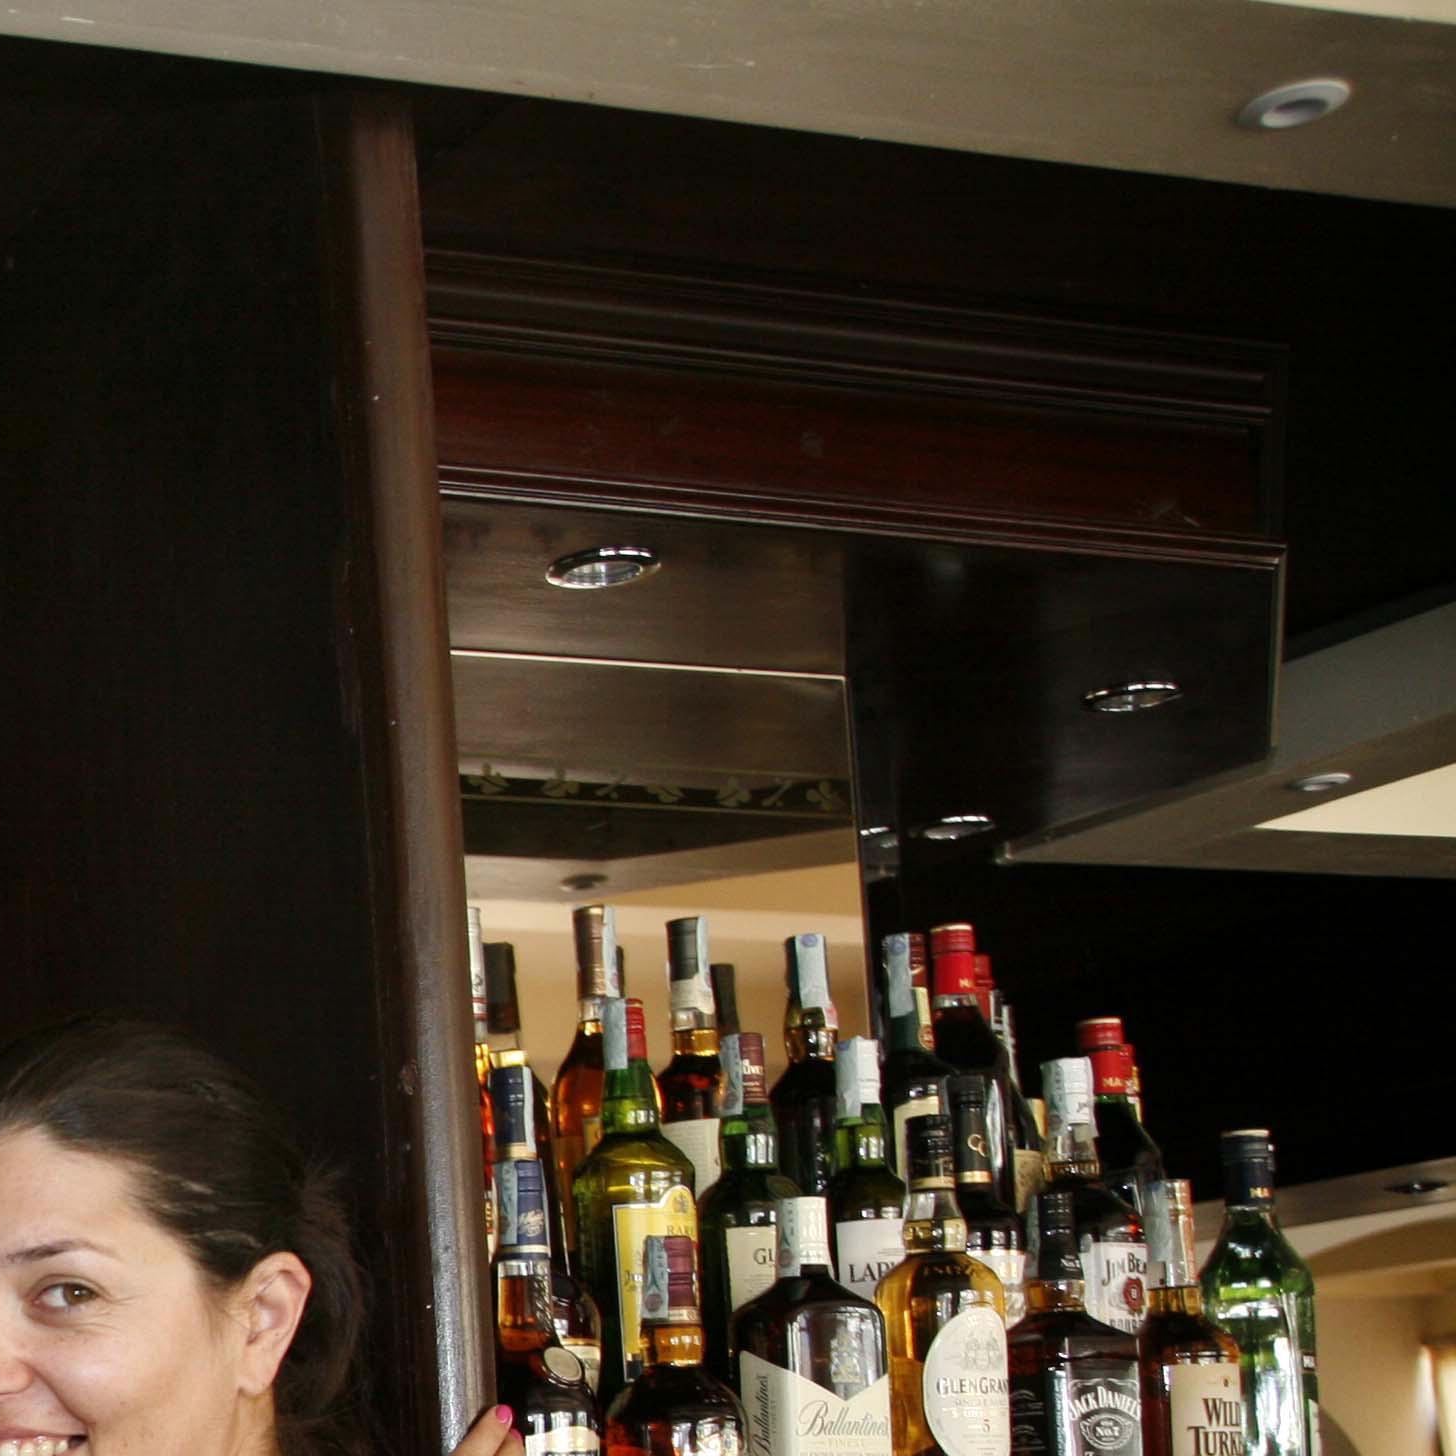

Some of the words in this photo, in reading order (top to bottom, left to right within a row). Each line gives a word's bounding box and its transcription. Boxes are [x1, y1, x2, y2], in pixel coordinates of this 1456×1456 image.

[1127, 1252, 1147, 1275] BEA
[796, 1400, 889, 1437] Ballantine's
[1068, 1391, 1098, 1421] JACK
